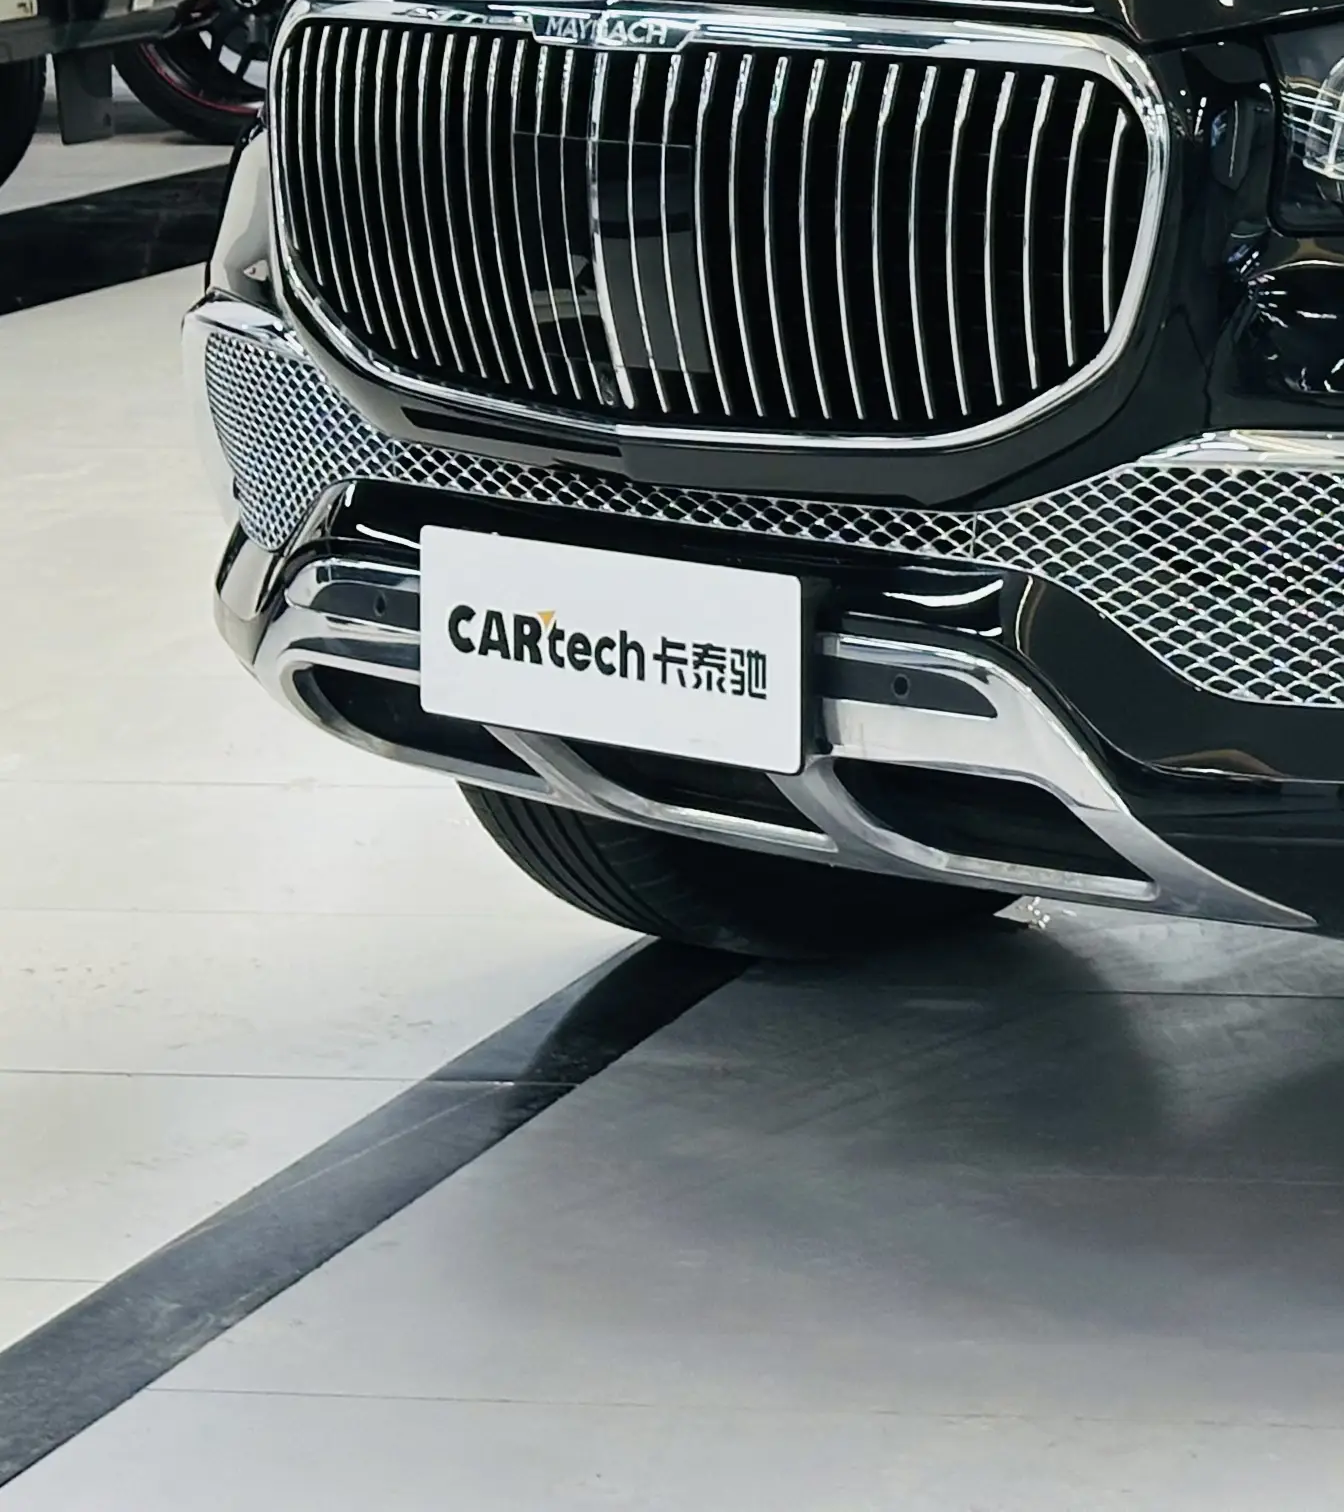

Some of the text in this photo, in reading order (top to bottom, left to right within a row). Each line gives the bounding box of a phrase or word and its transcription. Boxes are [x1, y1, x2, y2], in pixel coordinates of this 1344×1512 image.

[447, 603, 769, 701] CARtech 卡泰驰
